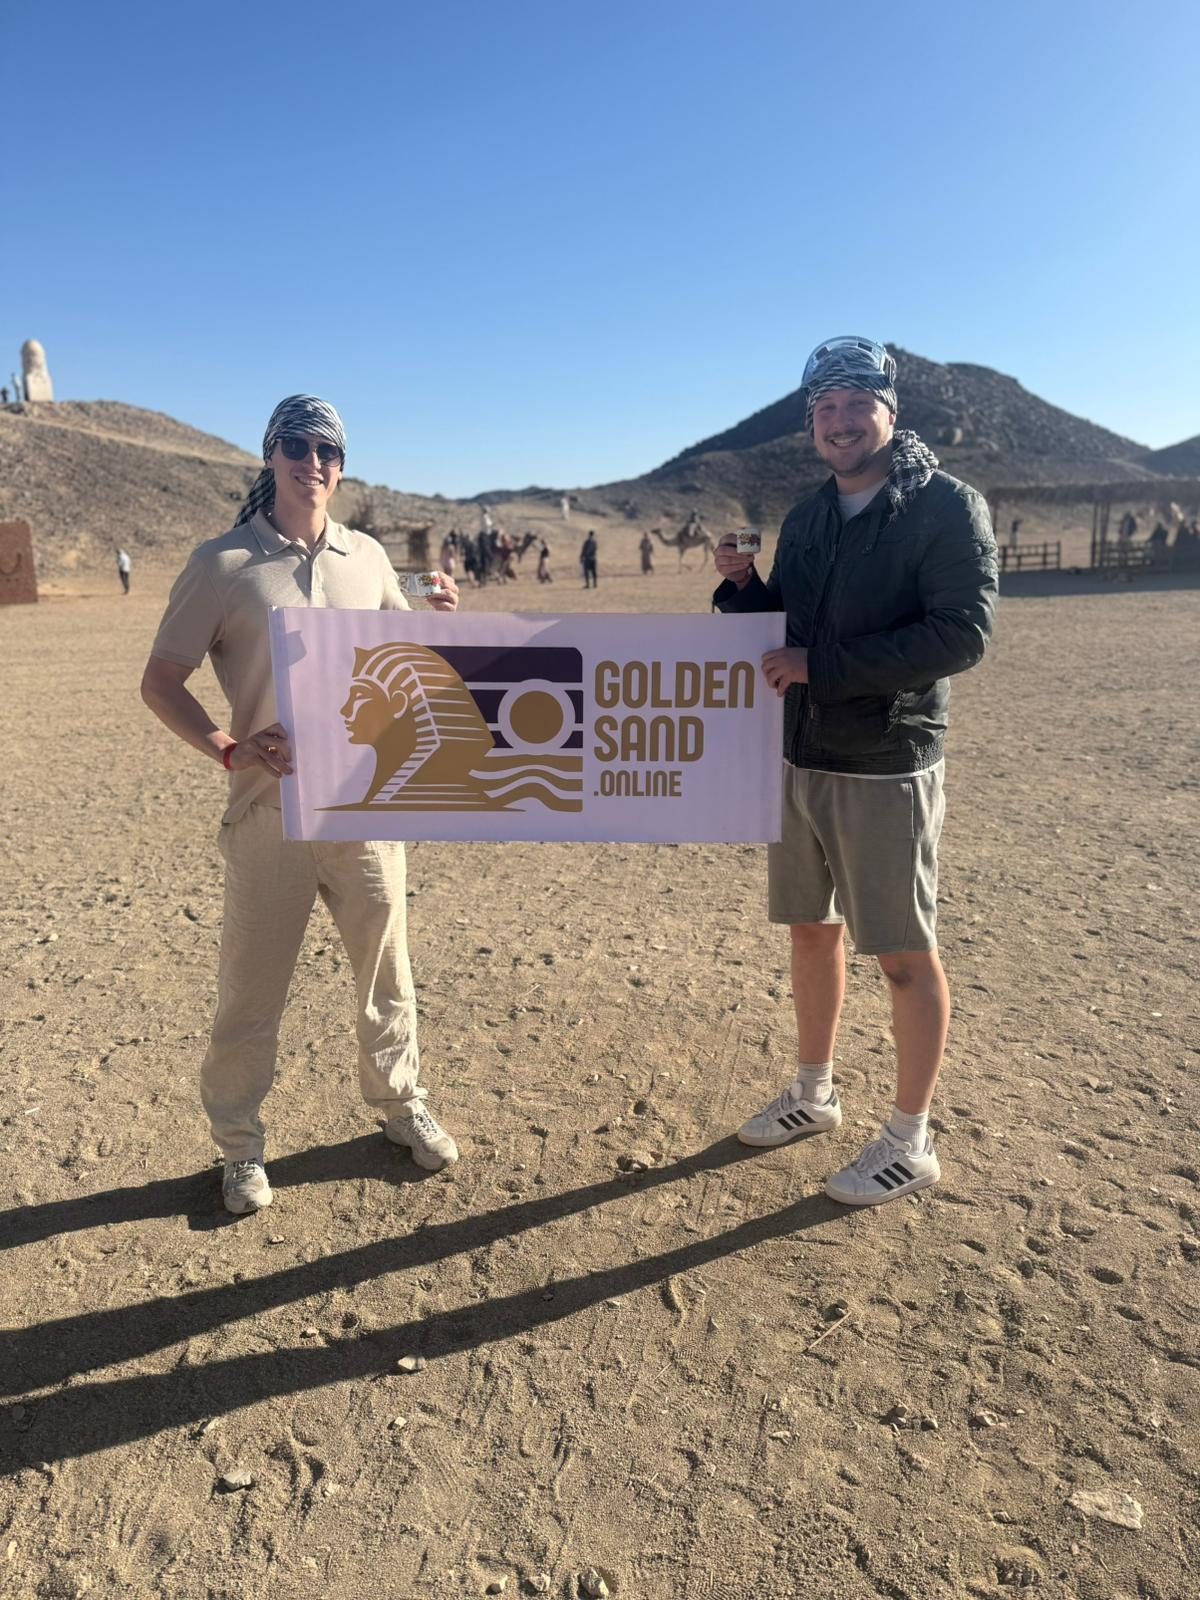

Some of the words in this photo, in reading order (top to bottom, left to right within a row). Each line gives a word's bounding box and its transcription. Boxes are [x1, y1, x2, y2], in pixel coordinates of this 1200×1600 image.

[594, 660, 755, 709] GOLDEN
[594, 715, 704, 762] SAND
[593, 769, 682, 797] .ONLINE
